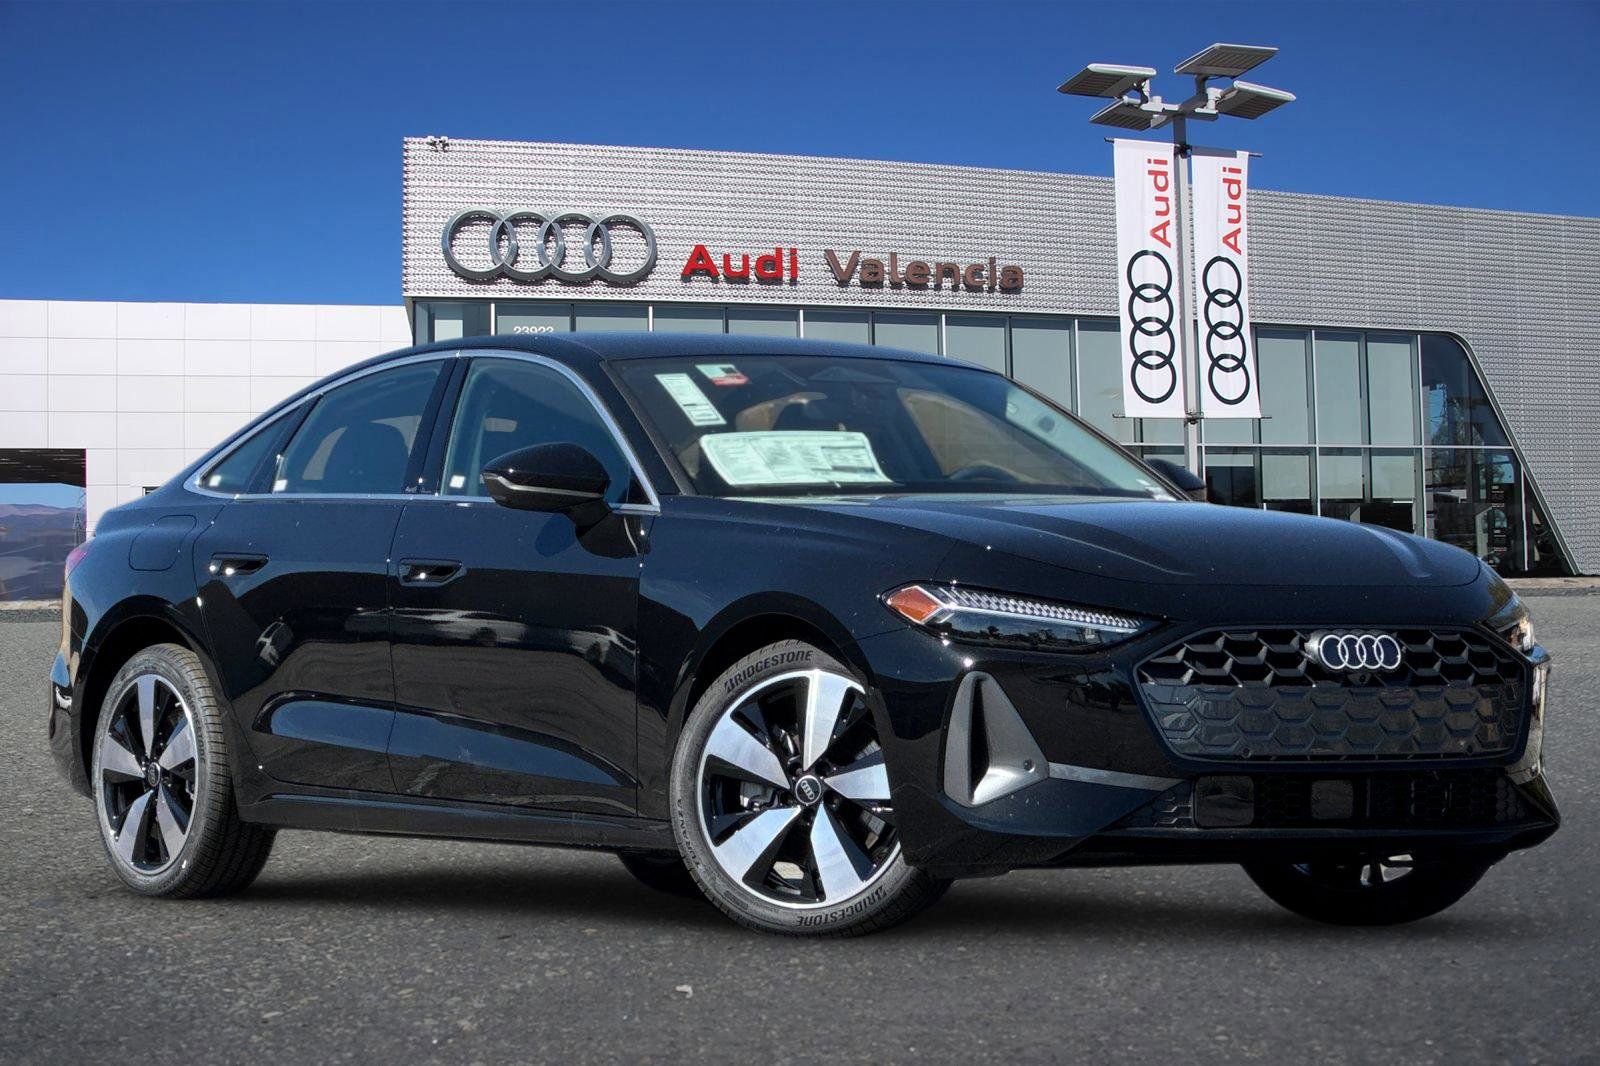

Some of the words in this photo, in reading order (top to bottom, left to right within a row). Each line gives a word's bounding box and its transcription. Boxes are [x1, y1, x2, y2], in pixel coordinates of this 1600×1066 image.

[1147, 158, 1172, 249] Audi
[1222, 166, 1242, 256] Audi
[681, 244, 798, 280] Audi
[824, 249, 1024, 290] Valencia
[724, 650, 814, 693] BRIDGESTONE
[796, 885, 888, 927] BRIDGESTONE
